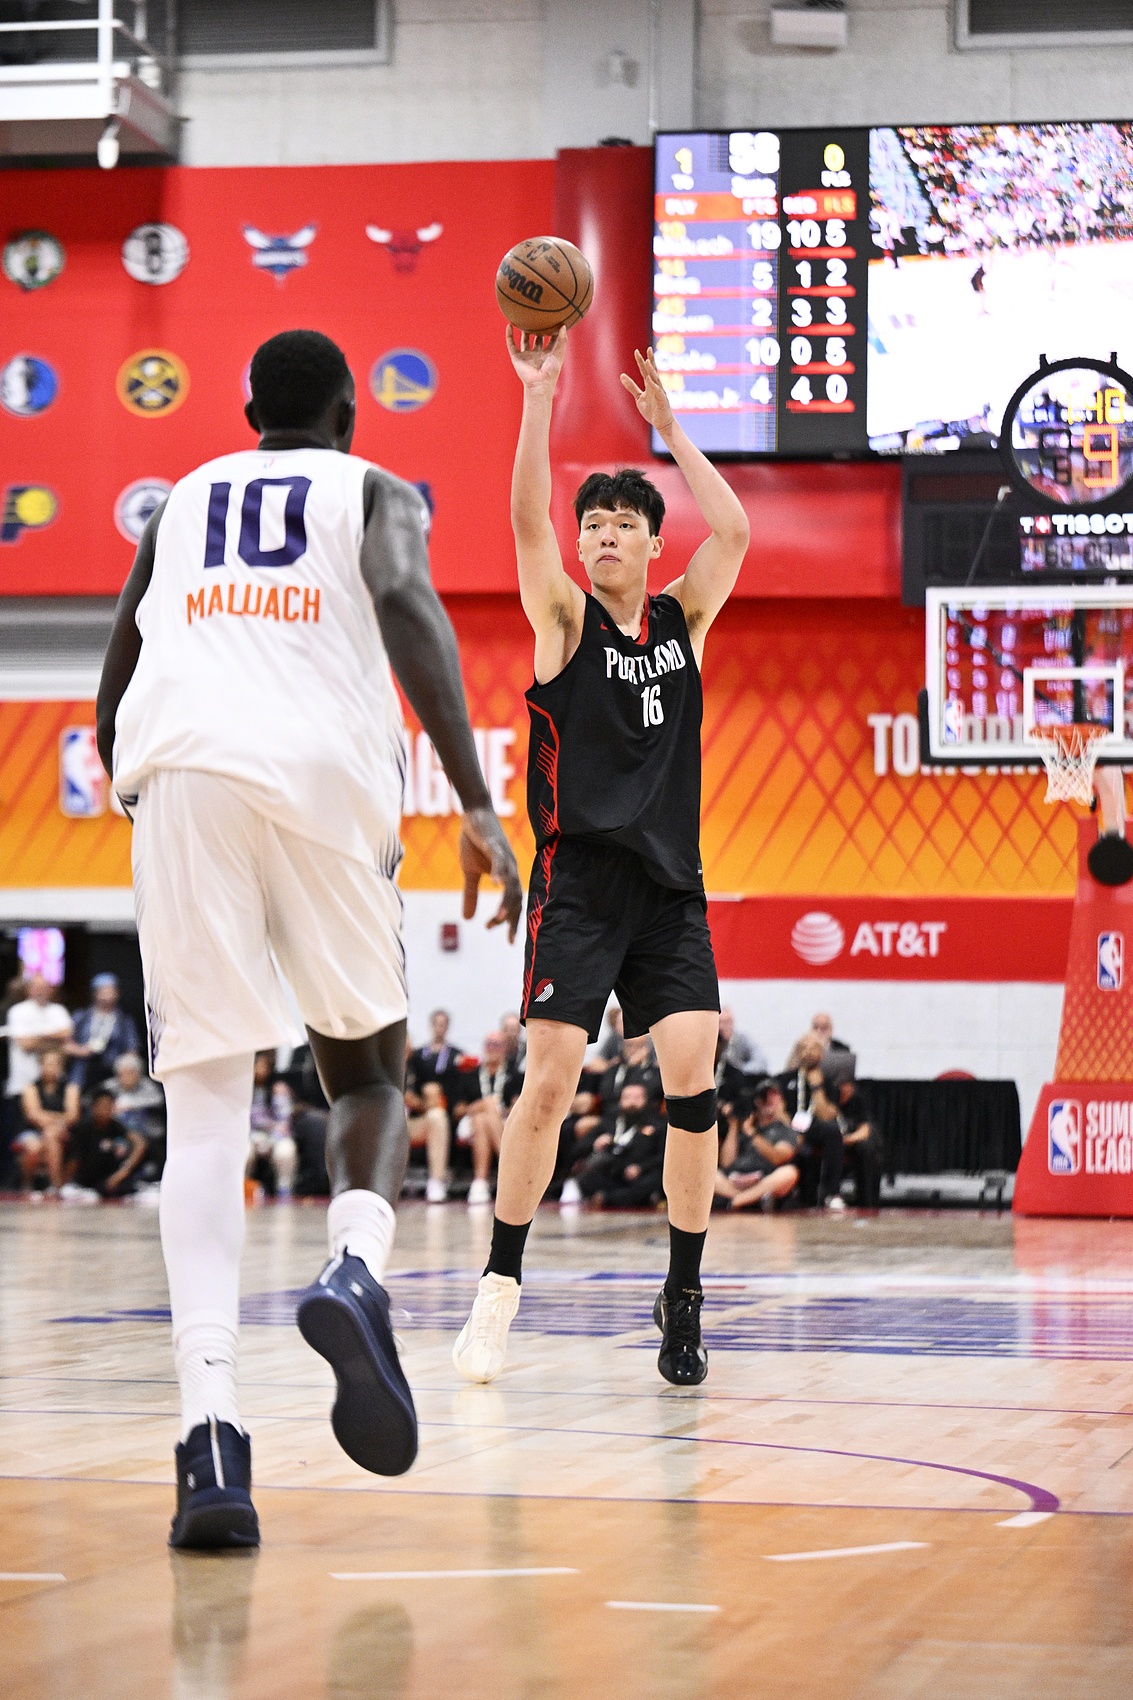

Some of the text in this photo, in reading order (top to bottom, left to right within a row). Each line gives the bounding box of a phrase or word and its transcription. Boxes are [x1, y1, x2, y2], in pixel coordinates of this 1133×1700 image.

[824, 143, 845, 172] 0
[746, 221, 781, 250] 19
[786, 219, 821, 248] 10
[825, 218, 846, 248] 5
[752, 257, 847, 290] 5 1 2
[751, 296, 847, 328] 2 3 3
[745, 337, 780, 366] 10
[790, 336, 812, 366] 0
[825, 336, 847, 366] 5
[750, 375, 773, 405] 4
[790, 375, 813, 405] 4
[825, 373, 848, 404] 0
[1083, 424, 1118, 488] 9
[204, 476, 312, 568] 10
[186, 583, 321, 626] MALUACH
[603, 639, 686, 685] PORTLAND
[640, 684, 665, 728] 16
[850, 921, 948, 958] AT&T
[1086, 1101, 1133, 1138] SUM
[1086, 1138, 1133, 1174] LEAG
